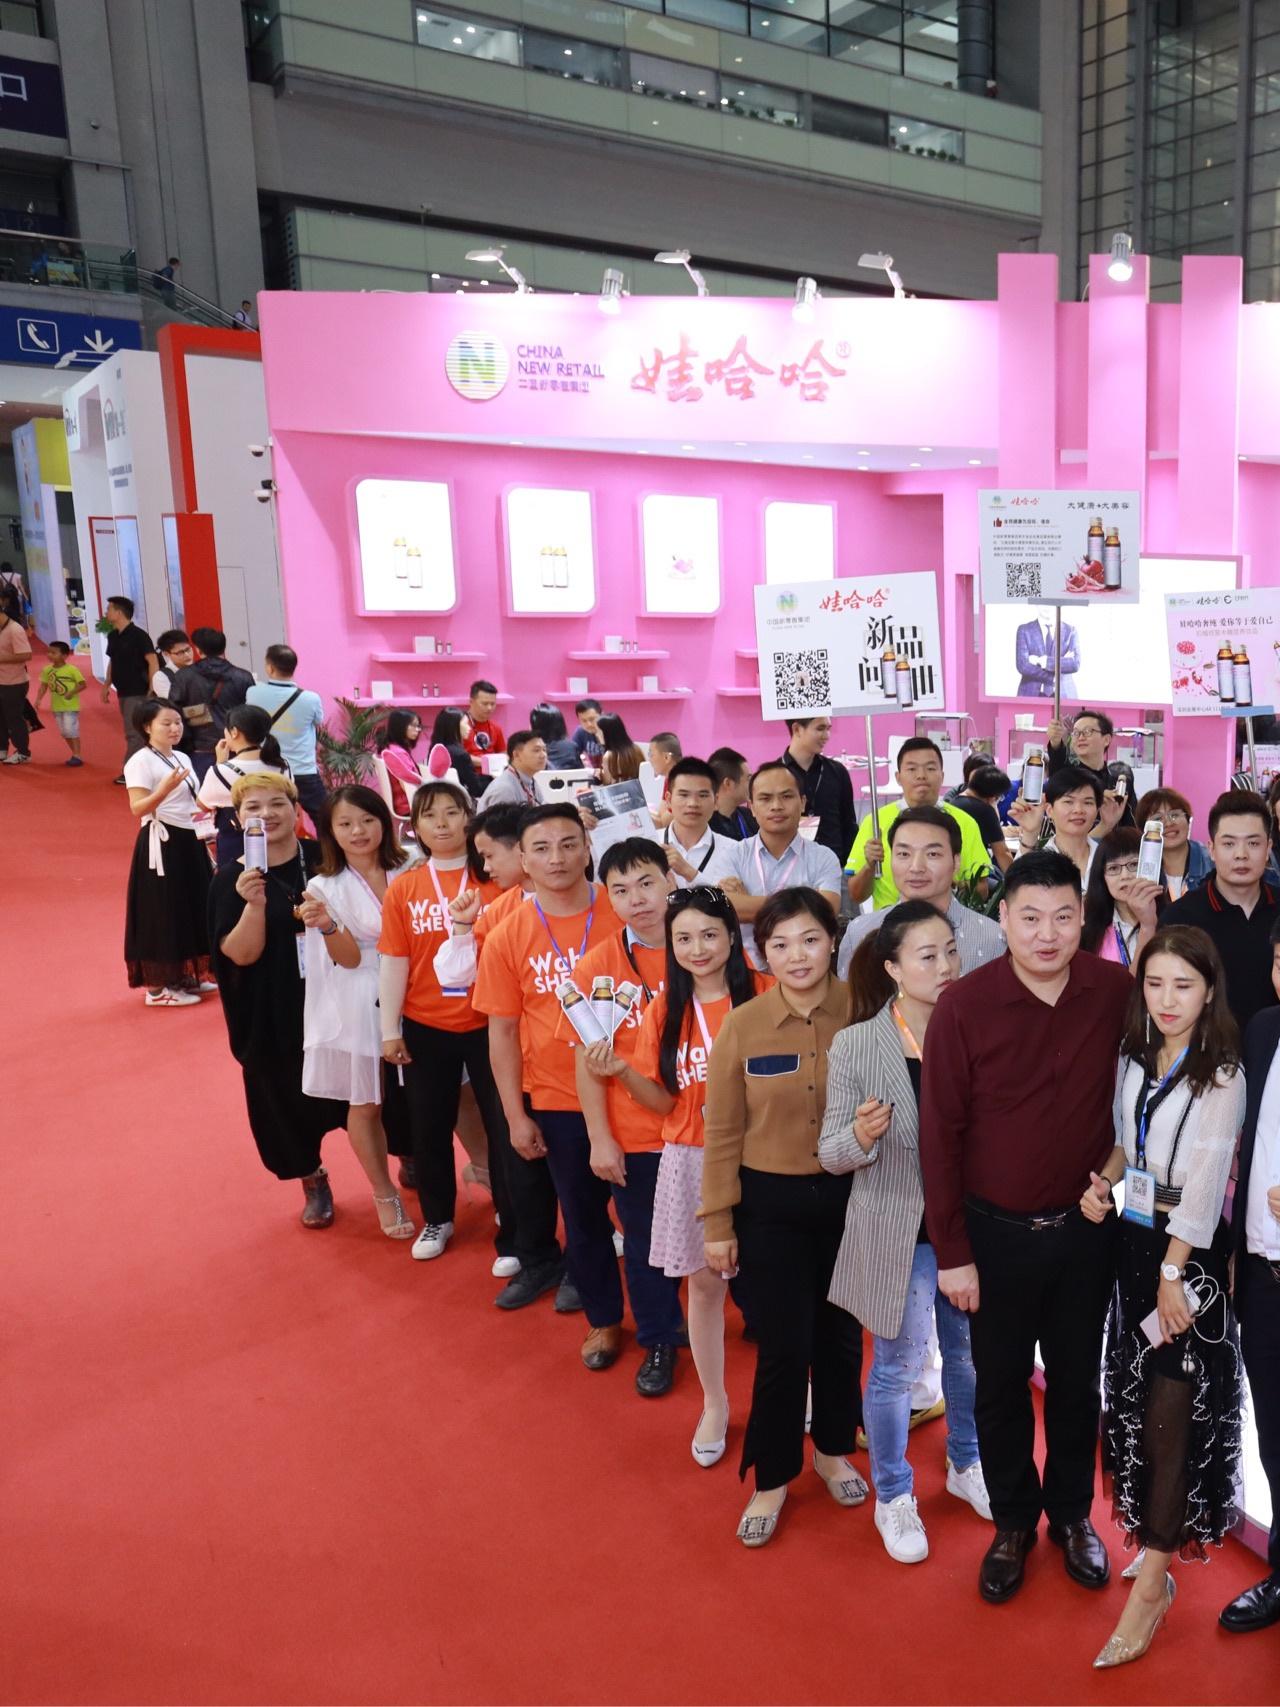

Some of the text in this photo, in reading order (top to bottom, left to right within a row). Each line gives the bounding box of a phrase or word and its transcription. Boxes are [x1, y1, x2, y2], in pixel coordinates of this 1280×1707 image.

[516, 344, 564, 360] CHINA
[517, 361, 605, 379] NEW RETAIL
[630, 332, 846, 403] 娃哈哈
[819, 588, 888, 612] 娃哈哈
[412, 916, 444, 935] SHE
